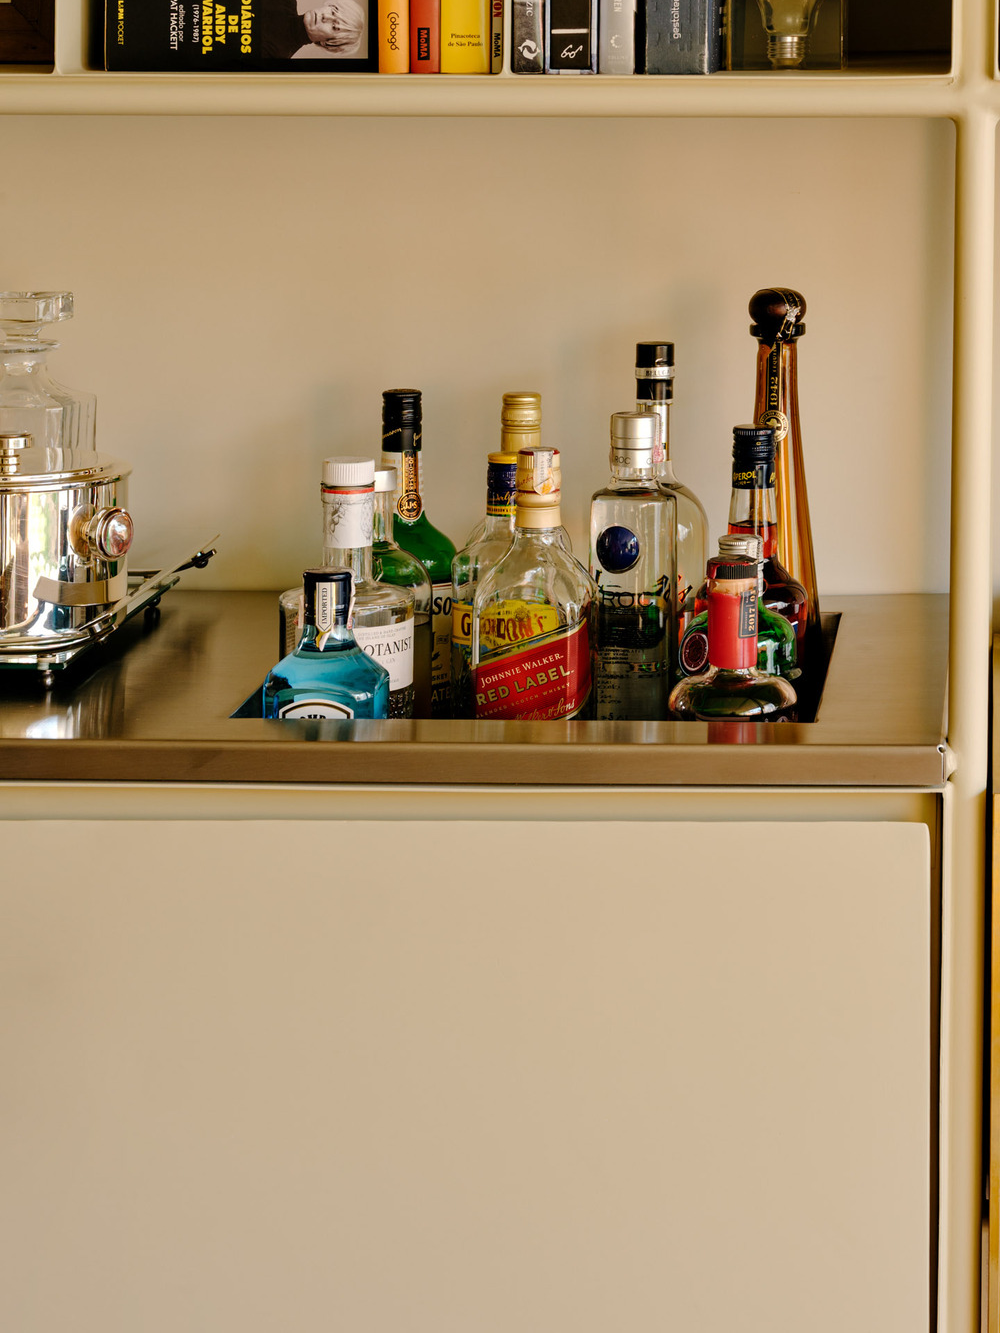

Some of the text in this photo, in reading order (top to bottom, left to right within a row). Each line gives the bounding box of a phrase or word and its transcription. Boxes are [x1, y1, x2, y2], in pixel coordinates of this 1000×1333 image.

[170, 11, 178, 50] HACKETT
[215, 4, 226, 45] ANDY
[228, 14, 239, 34] DE
[419, 30, 428, 57] MoMA
[493, 32, 501, 58] MoMA
[770, 376, 778, 406] 1942
[733, 471, 756, 481] APEROL
[481, 653, 561, 688] JOHNNIE WALKER
[476, 684, 510, 706] RED
[514, 665, 572, 693] LABEL
[511, 682, 570, 707] SCOTCH WHISKY
